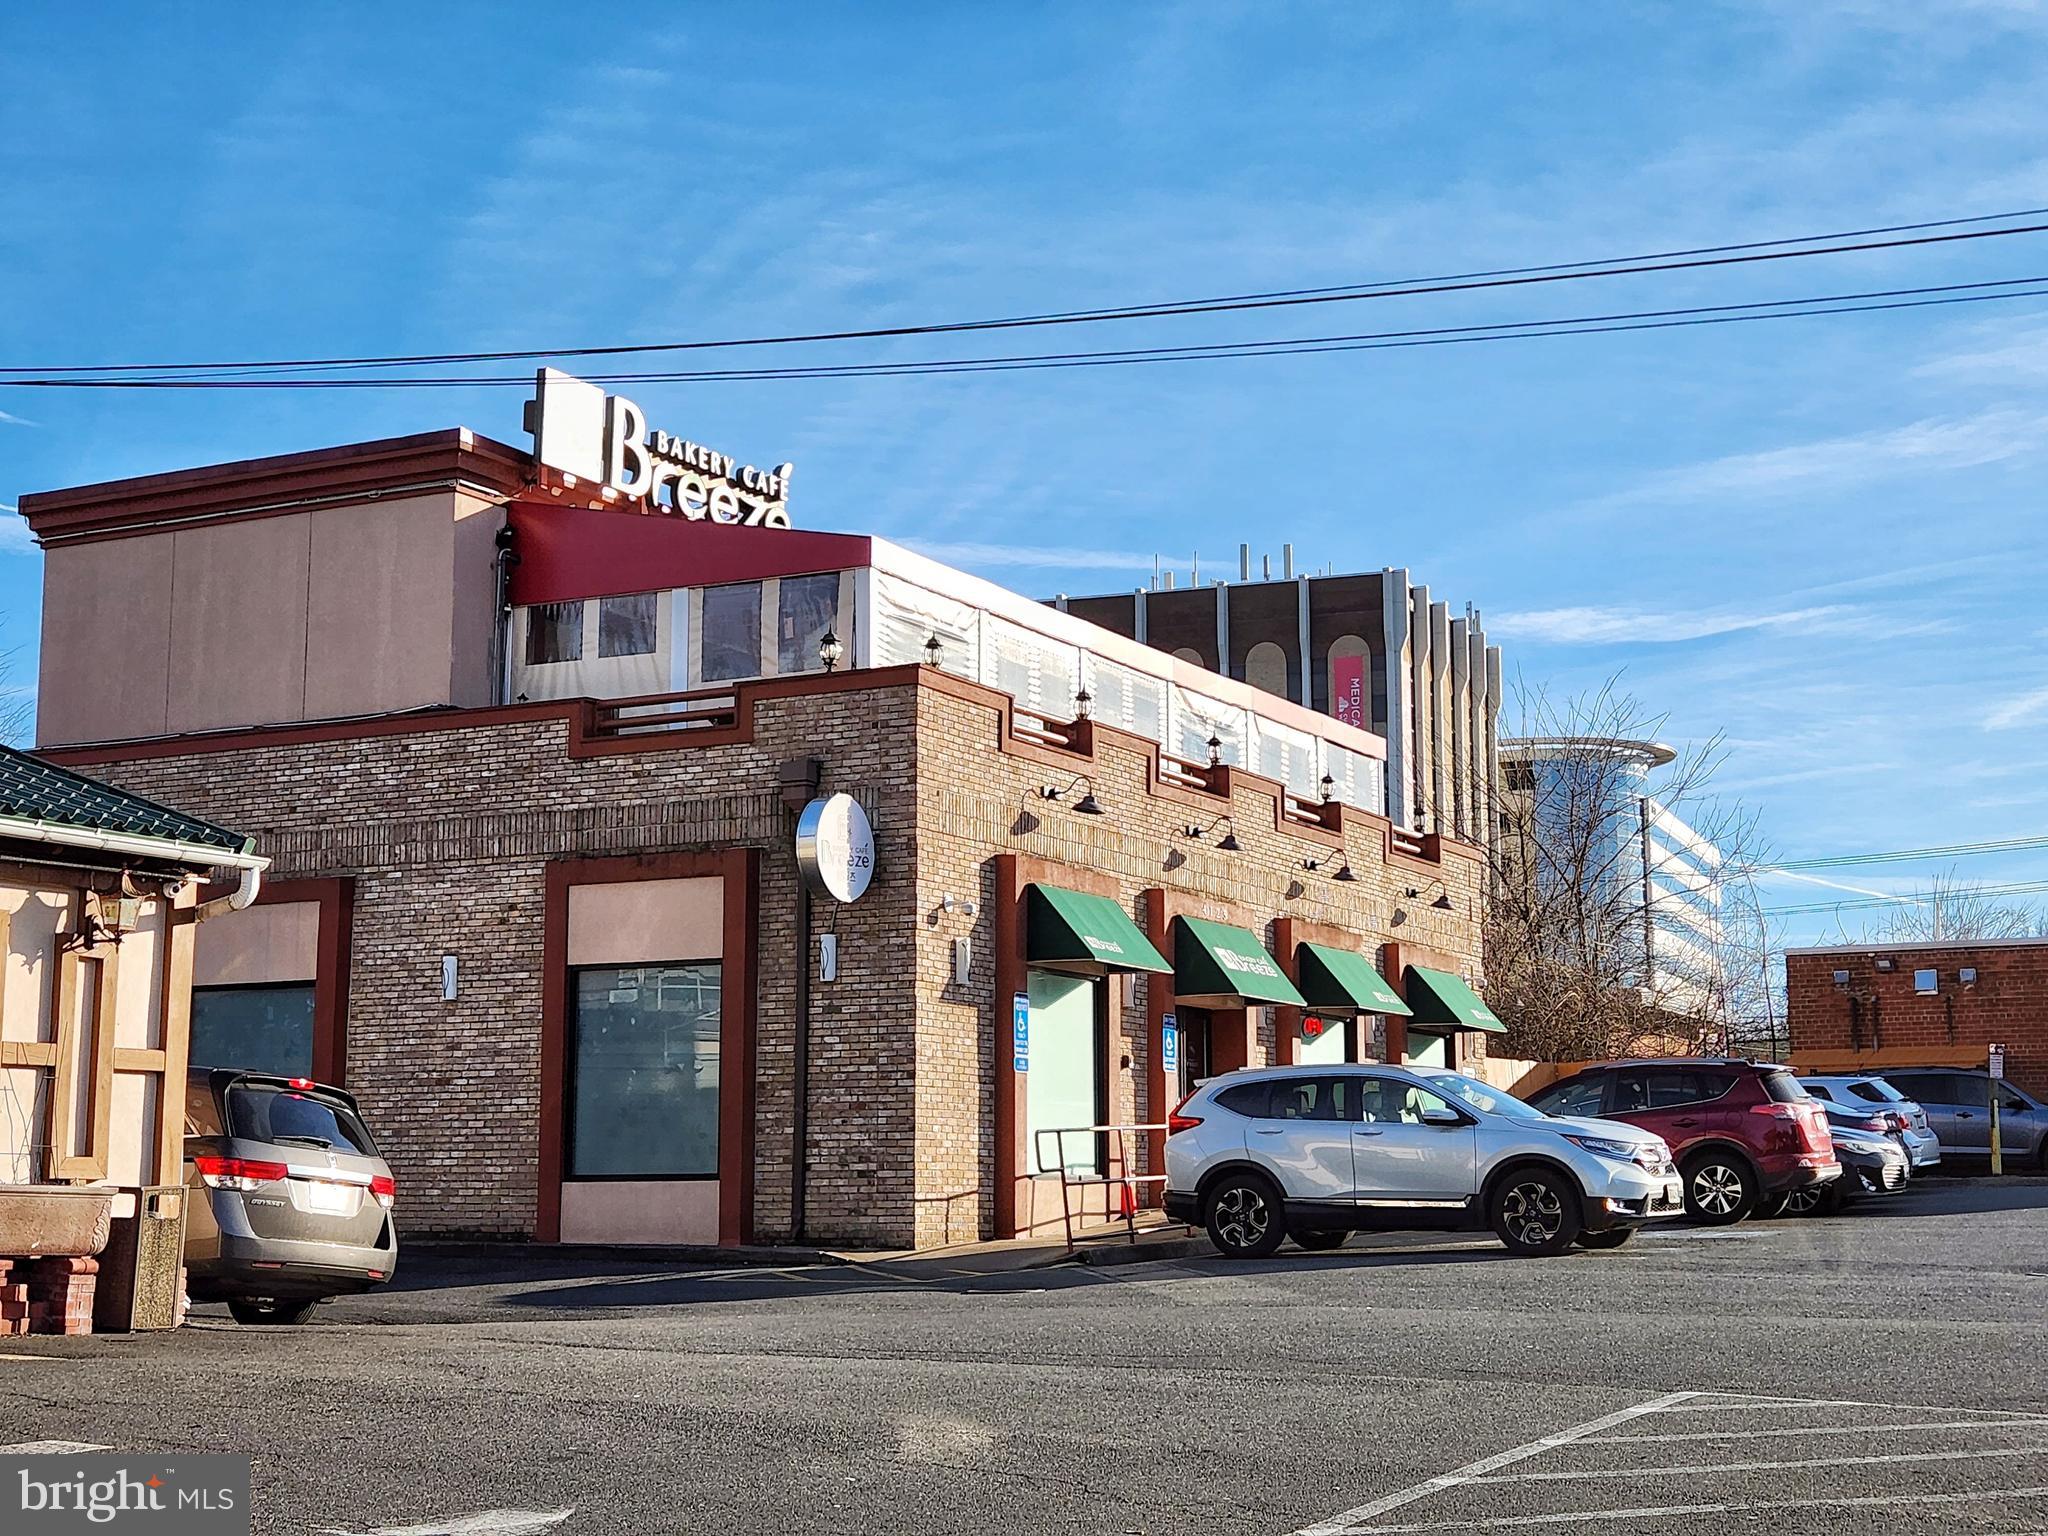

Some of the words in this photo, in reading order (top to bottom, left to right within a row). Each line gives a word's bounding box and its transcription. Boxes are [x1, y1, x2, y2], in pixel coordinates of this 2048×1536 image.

[609, 395, 792, 530] Breeze
[657, 429, 734, 479] BAKERY
[1226, 949, 1278, 978] Breeze
